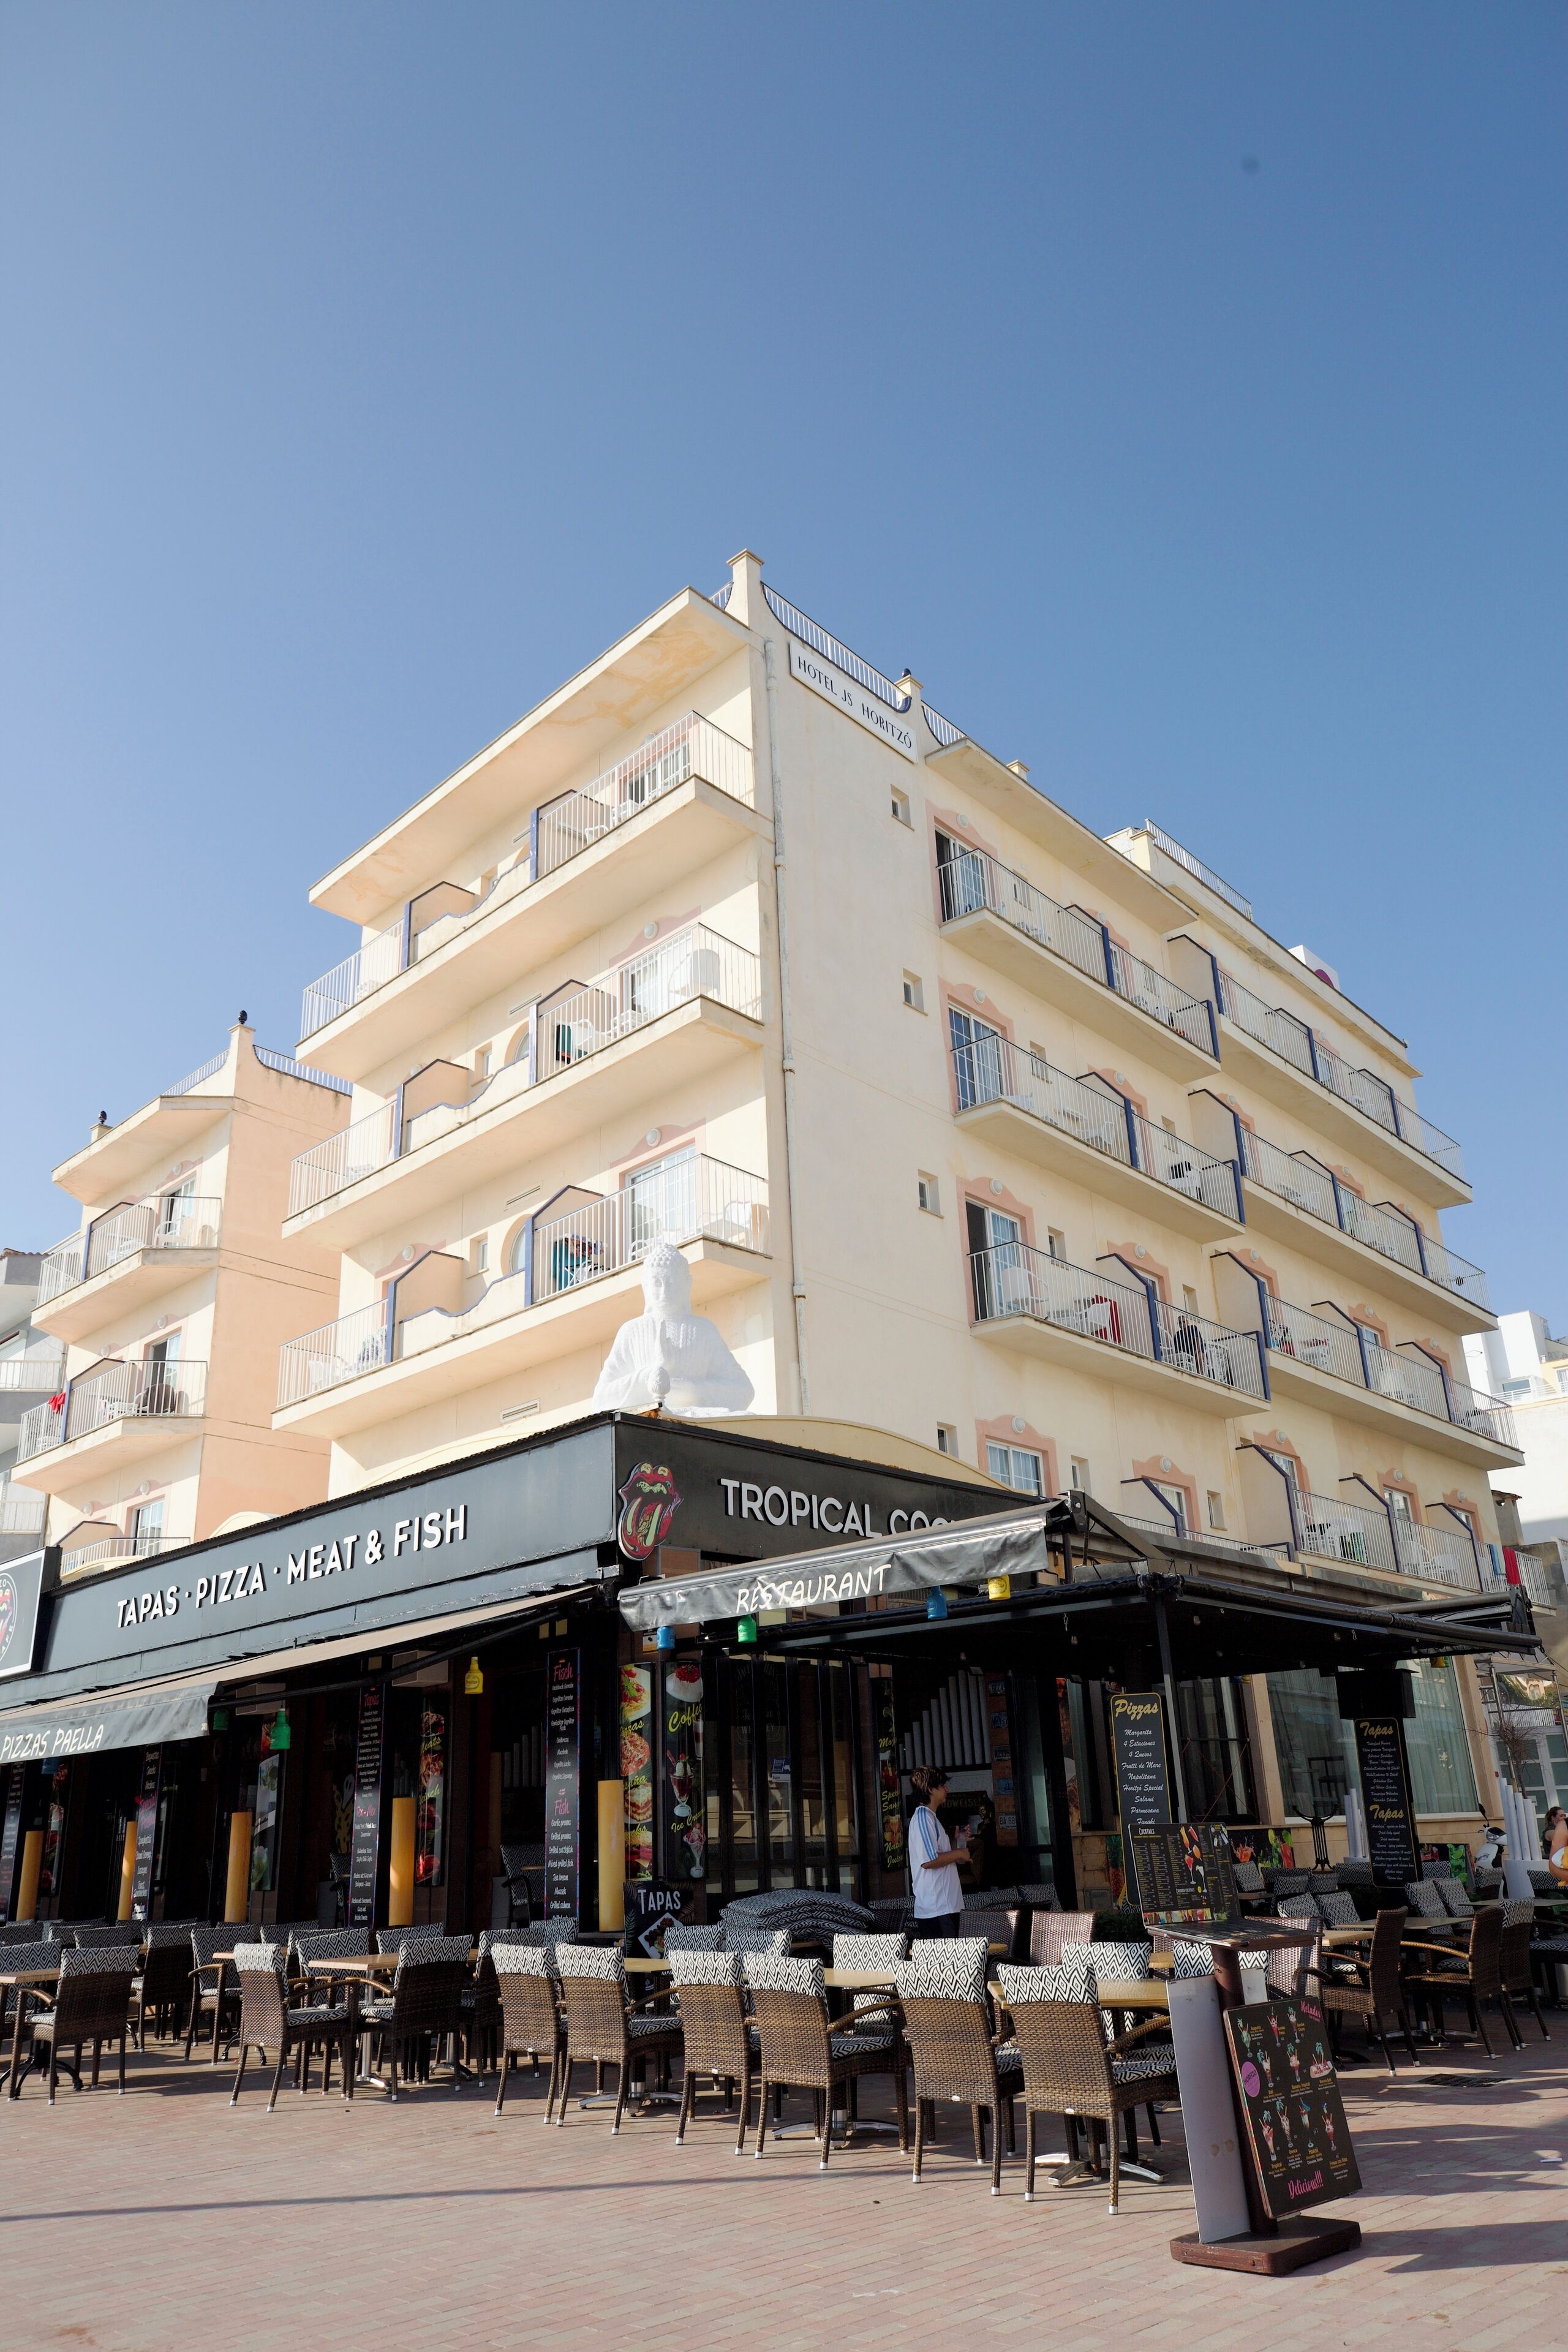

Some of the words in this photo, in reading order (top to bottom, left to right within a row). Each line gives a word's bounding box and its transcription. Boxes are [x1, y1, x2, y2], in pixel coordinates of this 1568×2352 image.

[798, 656, 837, 695] HOTEL
[842, 689, 853, 706] JS
[862, 703, 912, 748] HORITZÓ
[720, 1478, 882, 1539] TROPICAL
[890, 1509, 956, 1535] CO
[118, 1585, 179, 1628] TAPAS
[195, 1562, 265, 1608] PIZZA
[287, 1534, 360, 1585] MEAT
[364, 1529, 383, 1565] &
[394, 1504, 467, 1556] FISH
[737, 1564, 892, 1613] RESTAURANT
[554, 1662, 573, 1682] Fisch
[668, 1703, 703, 1733] Coffee
[1115, 1699, 1159, 1721] Pizzas
[1360, 1722, 1394, 1739] Tapas
[0, 1730, 51, 1761] PIZZAS
[51, 1724, 104, 1755] PAELLA
[420, 1736, 442, 1753] eats
[1127, 1773, 1156, 1781] Napolitana
[1144, 1784, 1164, 1792] Special
[554, 1798, 570, 1816] Fish
[1369, 1804, 1404, 1822] Tapas
[671, 1822, 685, 1833] Ice
[687, 1806, 706, 1826] Cream
[551, 1832, 560, 1841] Grilled
[549, 1845, 559, 1854] Grilled
[550, 1901, 560, 1909] Grilled
[638, 1890, 681, 1915] TAPAS
[1300, 2000, 1322, 2018] Helados
[1288, 2169, 1324, 2199] Delicious!!!
